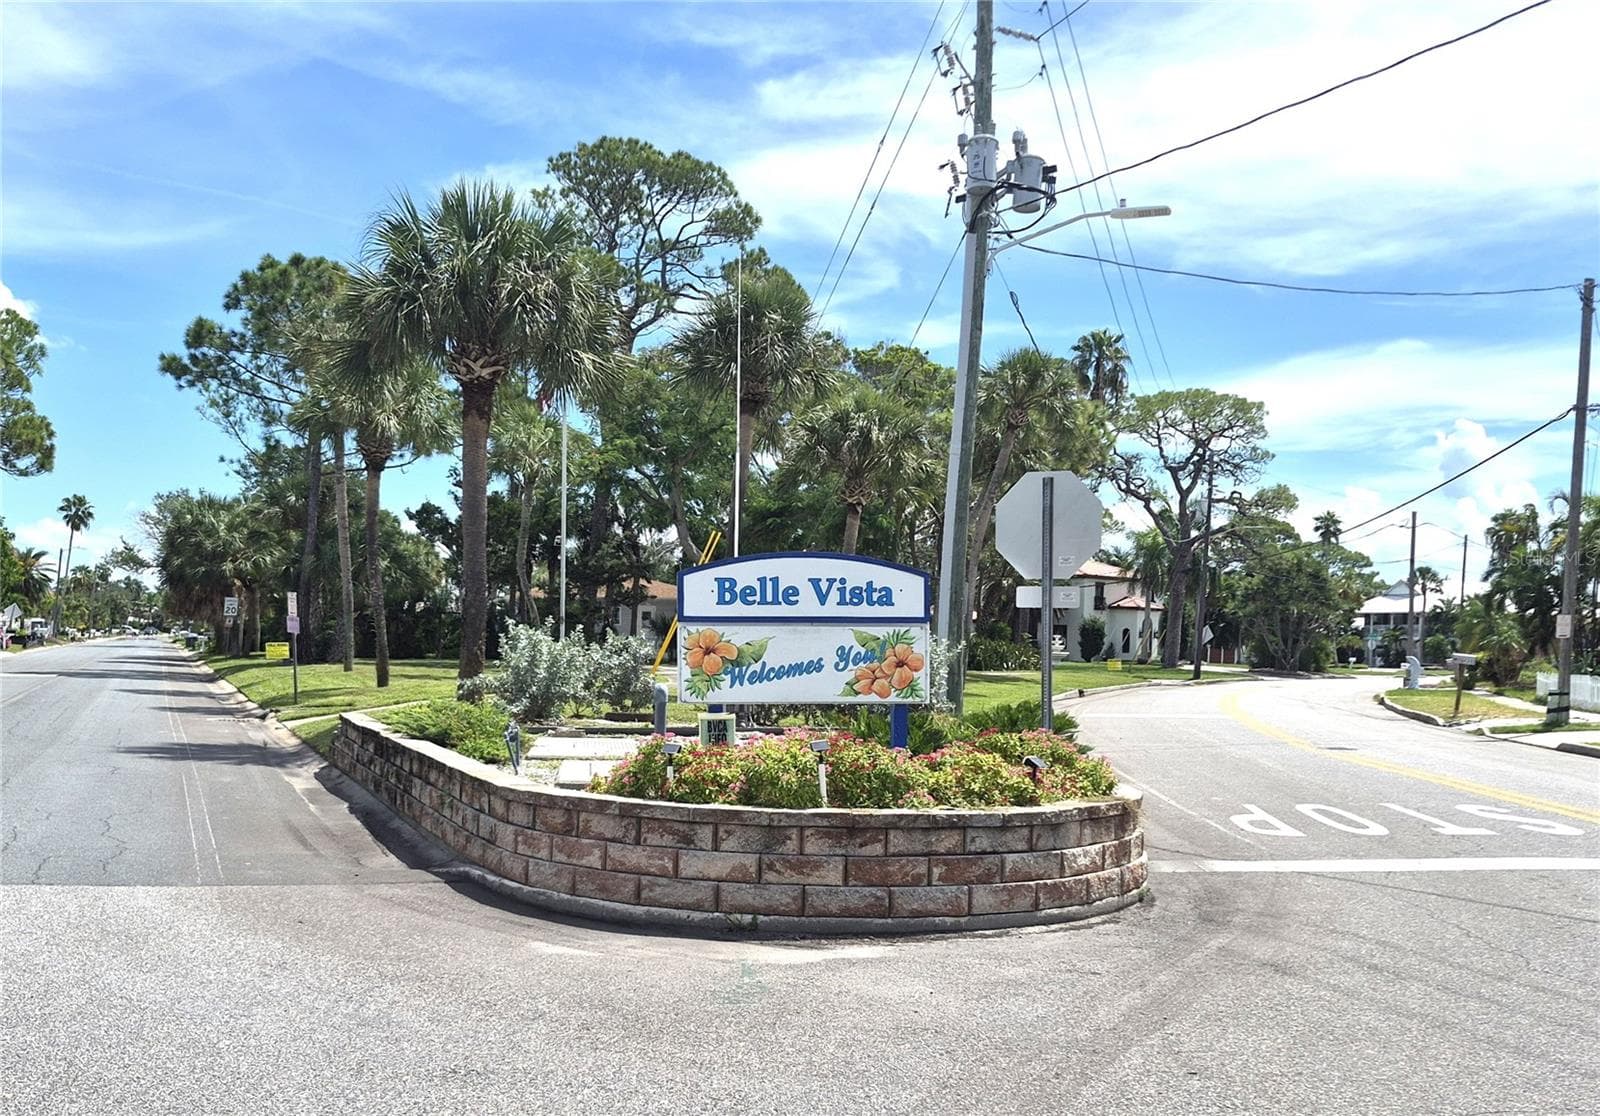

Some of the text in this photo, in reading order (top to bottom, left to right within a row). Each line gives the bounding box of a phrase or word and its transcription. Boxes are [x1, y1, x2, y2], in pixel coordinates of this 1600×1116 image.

[714, 576, 895, 606] Belle Vista
[225, 606, 236, 614] 20
[724, 656, 824, 689] Welcomes
[1229, 803, 1585, 837] STOP
